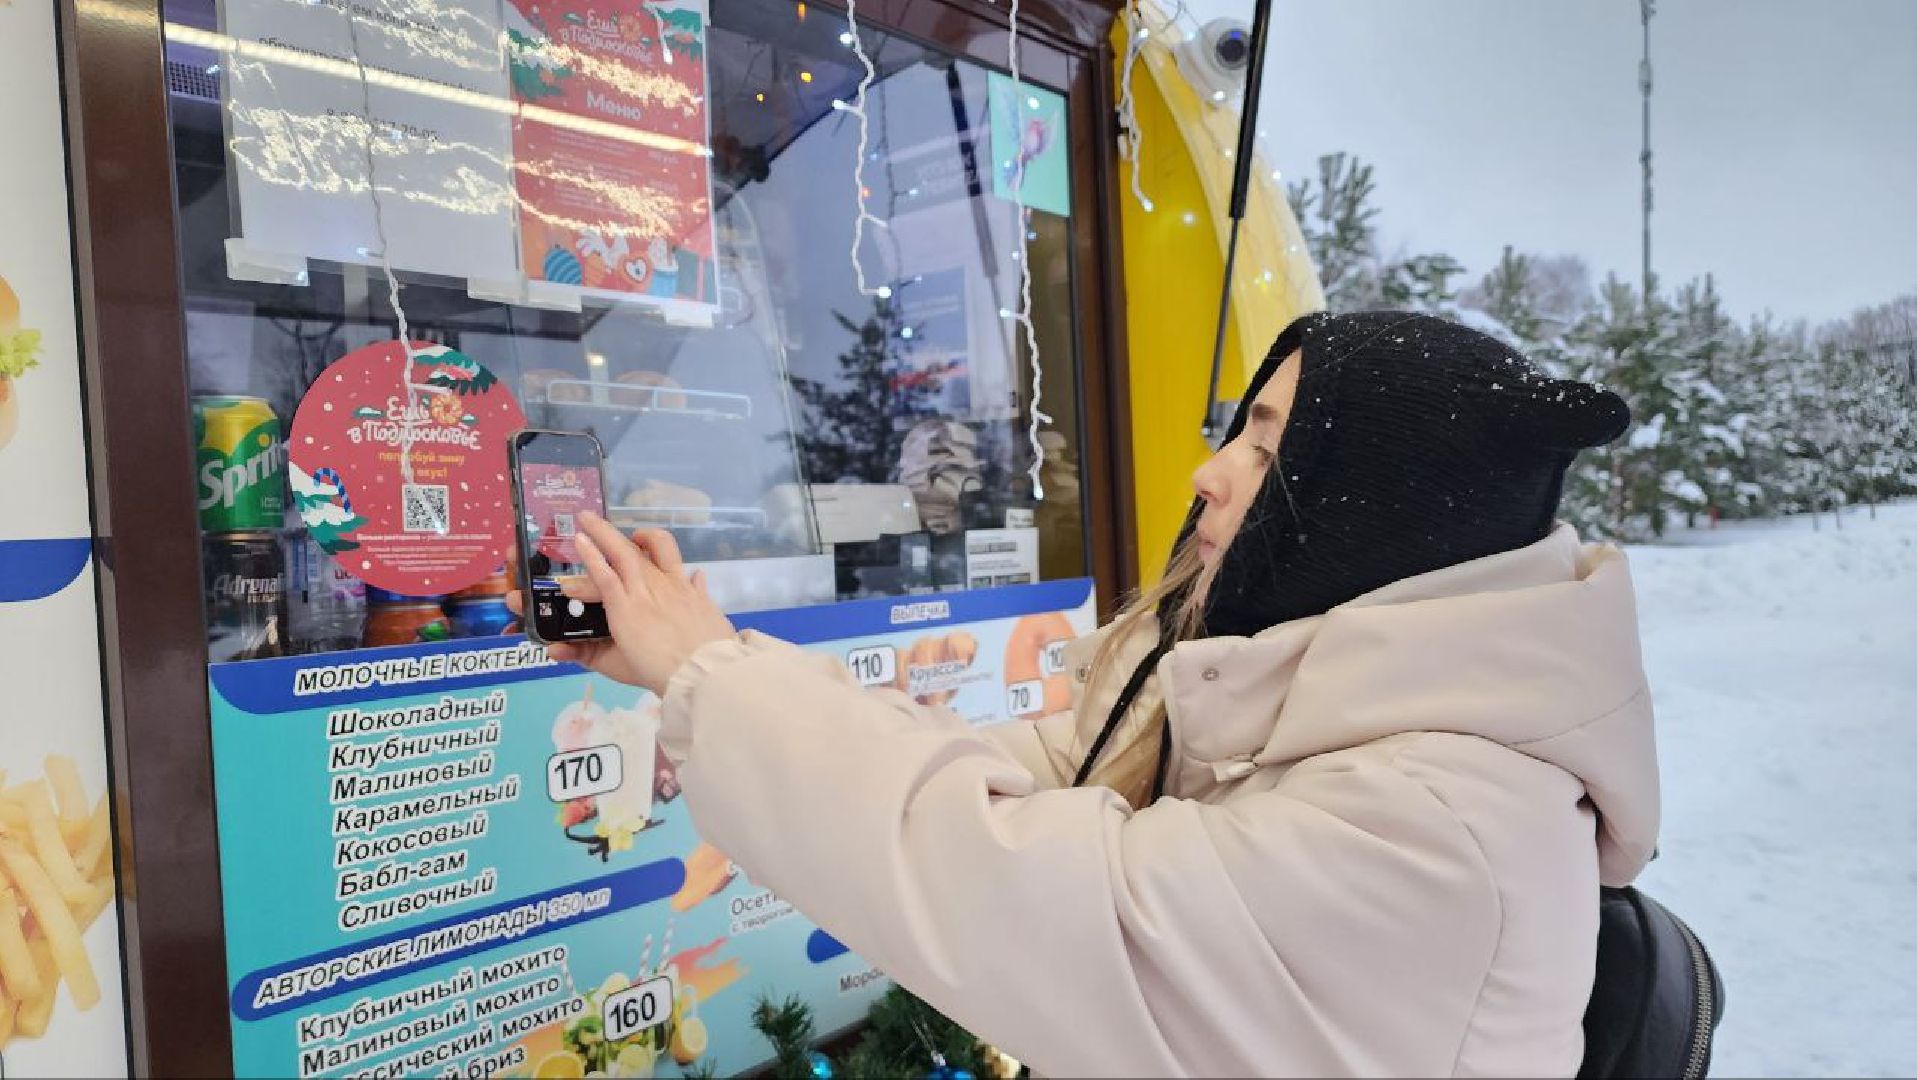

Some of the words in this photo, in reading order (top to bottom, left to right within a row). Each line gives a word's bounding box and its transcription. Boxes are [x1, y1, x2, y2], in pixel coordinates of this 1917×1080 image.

[586, 88, 642, 121] Меню
[346, 426, 363, 444] в
[379, 450, 436, 465] попбуй
[199, 436, 282, 511] Sprit
[214, 572, 284, 603] Adrenal
[893, 602, 948, 621] ВЫПЕЧКА
[297, 658, 444, 693] МОЛОЧНЫЕ
[448, 643, 552, 675] КОКТЕЙЛ
[852, 653, 883, 680] 110
[329, 692, 504, 737] Шоколадный
[1010, 686, 1029, 711] 70
[331, 721, 499, 769] Клубничный
[334, 753, 493, 800] Малиновый
[554, 753, 603, 790] 170
[335, 777, 518, 833] Карамельный
[337, 813, 486, 865] Кокосовый
[340, 852, 465, 897] Бабл-гам
[342, 872, 494, 929] Сливочный
[731, 892, 777, 916] Осет
[258, 942, 409, 1003] АВТОРСКИЕ
[413, 902, 547, 958] ЛИМОНАДЫ
[549, 893, 583, 918] 350
[585, 891, 610, 908] мл
[300, 970, 474, 1043] Клубничный
[482, 947, 565, 986] мохито
[608, 991, 656, 1033] 160
[303, 1004, 467, 1076] Малиновый
[475, 976, 560, 1018] мохито
[347, 1025, 493, 1079] ссический
[501, 997, 584, 1039] мохито
[467, 1046, 526, 1079] бриз
